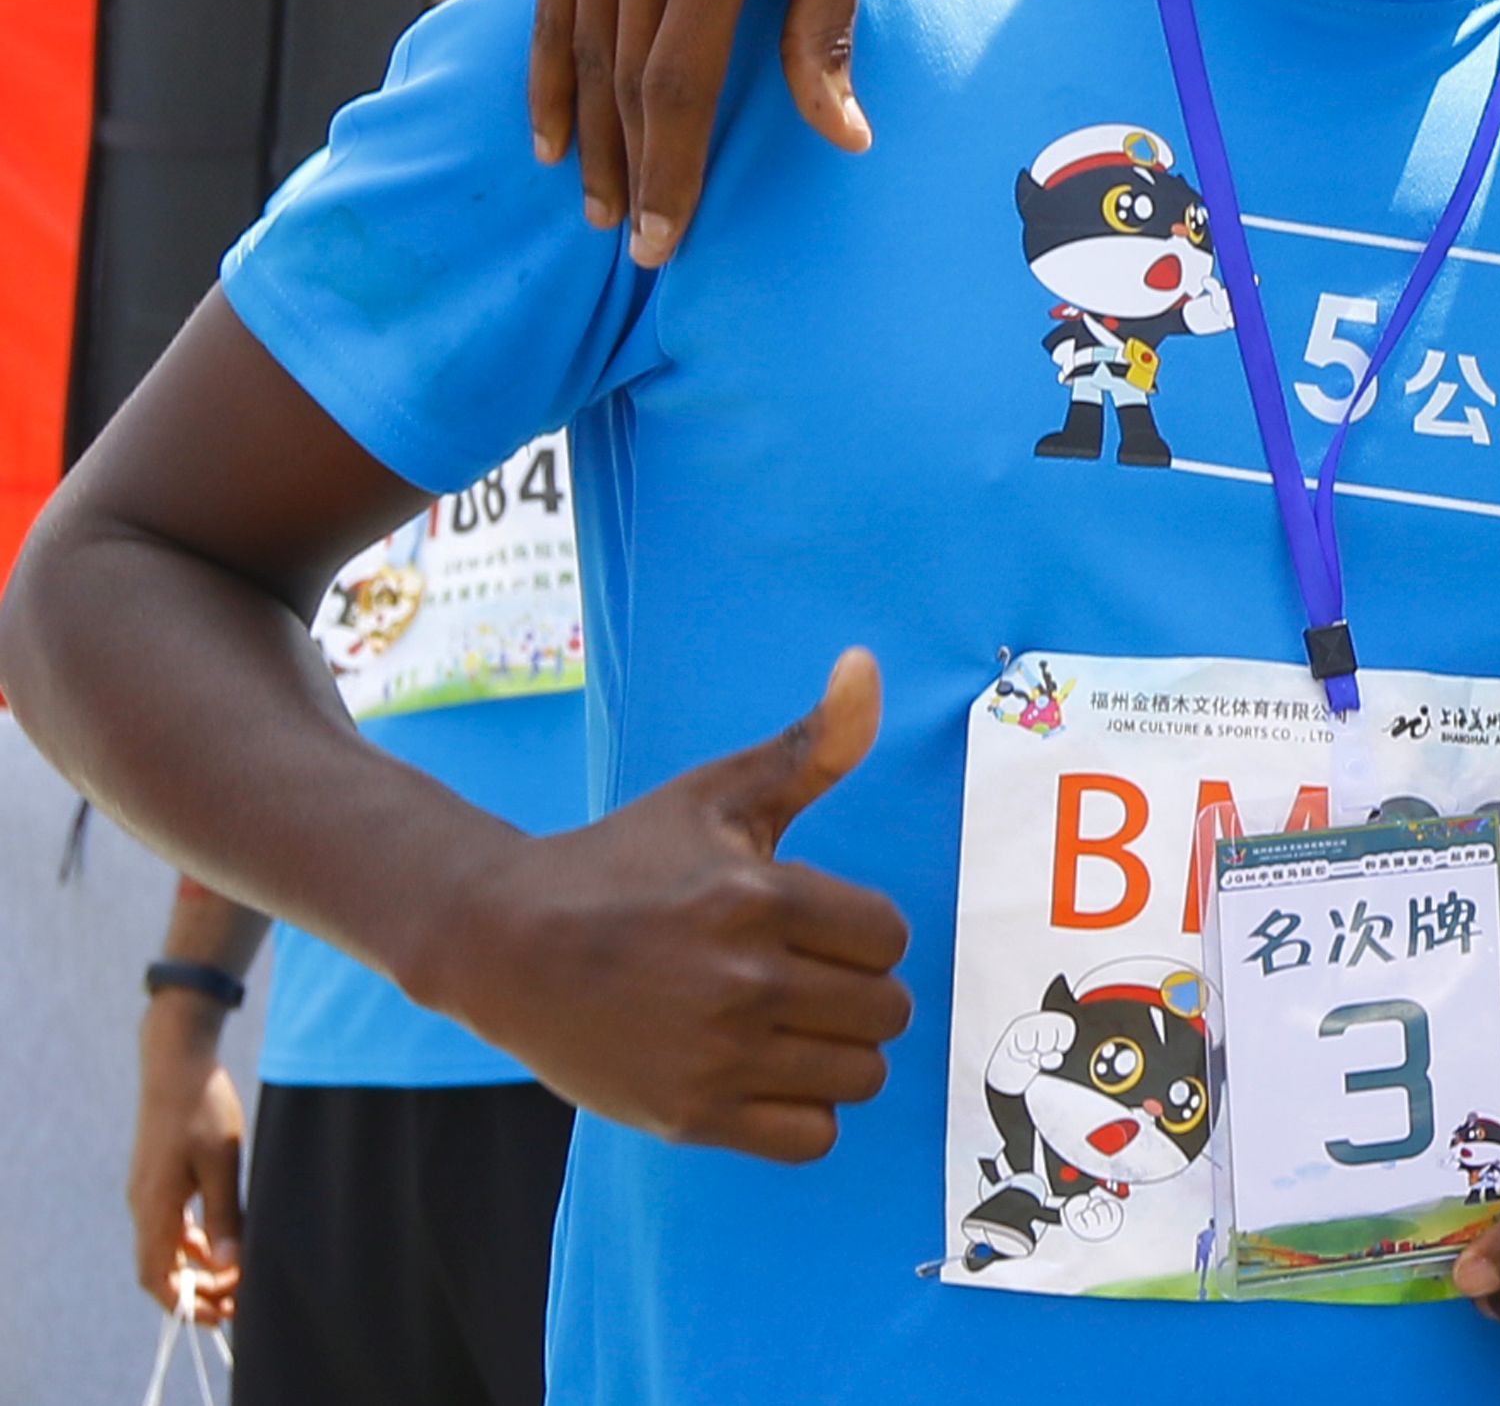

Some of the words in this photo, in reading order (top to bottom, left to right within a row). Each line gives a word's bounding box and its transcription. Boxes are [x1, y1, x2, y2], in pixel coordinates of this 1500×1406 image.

[1106, 720, 1135, 732] JQM
[1139, 720, 1199, 736] CULTURE
[1203, 723, 1214, 736] &
[1218, 724, 1269, 740] SPORTS
[1309, 730, 1335, 743] LTD
[1243, 890, 1483, 977] 名次牌
[1318, 997, 1435, 1167] 3
